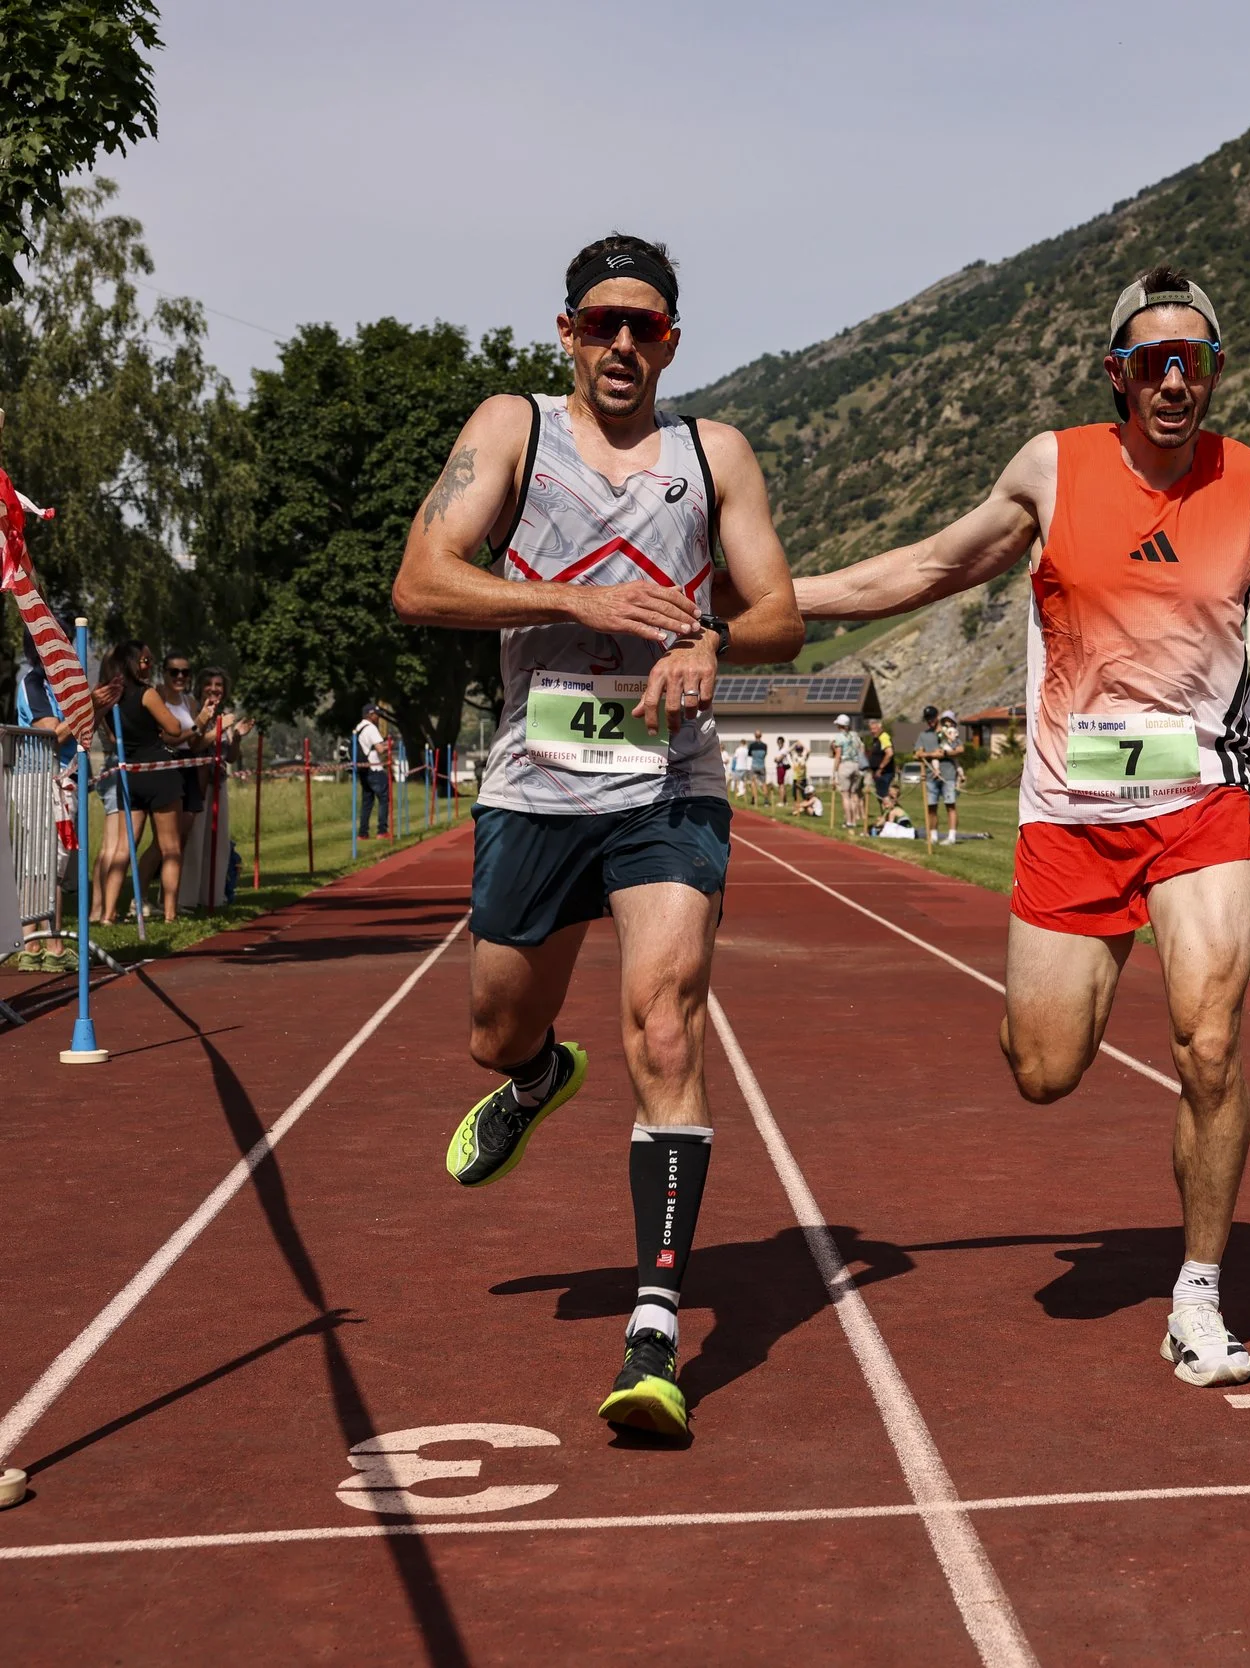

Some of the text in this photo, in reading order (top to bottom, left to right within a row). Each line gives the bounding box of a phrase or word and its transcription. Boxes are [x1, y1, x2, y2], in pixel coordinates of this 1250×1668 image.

[541, 678, 594, 691] stv gampel
[614, 679, 648, 692] lonzala
[570, 701, 625, 740] 42
[1078, 720, 1126, 731] stv gampel
[1145, 718, 1185, 729] lonzalauf
[530, 749, 577, 760] RAIFFEISEN
[616, 755, 663, 764] RAIFFEISEN
[1119, 740, 1144, 776] 7
[1152, 785, 1198, 796] RAIFFEISEN
[663, 1149, 678, 1246] COMPRESSPORT
[335, 1422, 561, 1515] 3
